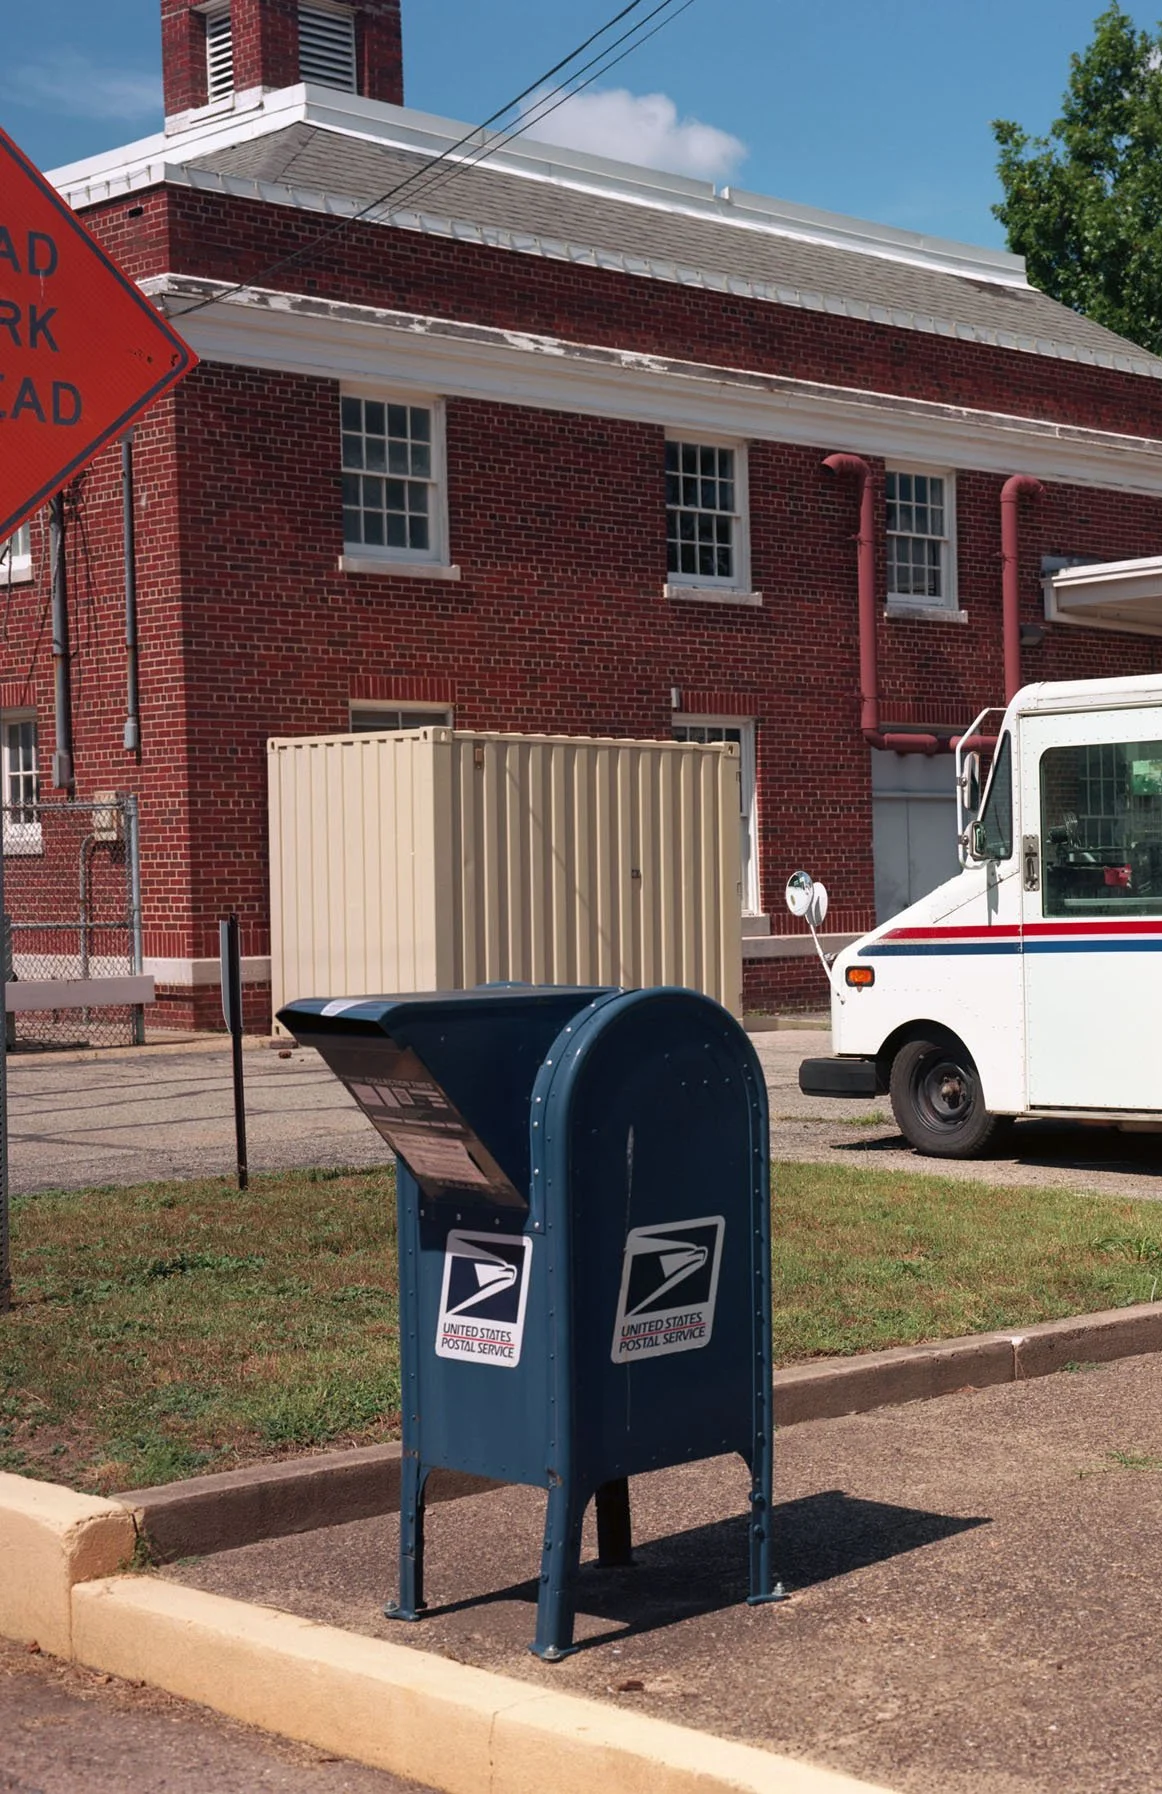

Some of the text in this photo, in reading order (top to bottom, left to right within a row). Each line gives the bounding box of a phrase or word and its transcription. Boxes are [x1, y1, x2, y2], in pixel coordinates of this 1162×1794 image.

[0, 372, 82, 427] AD
[443, 1322, 513, 1343] UNITED STATES
[620, 1311, 703, 1338] UNITED STATES
[441, 1337, 515, 1359] POSTAL SERVICE
[618, 1326, 706, 1354] POSTAL SERVICE
